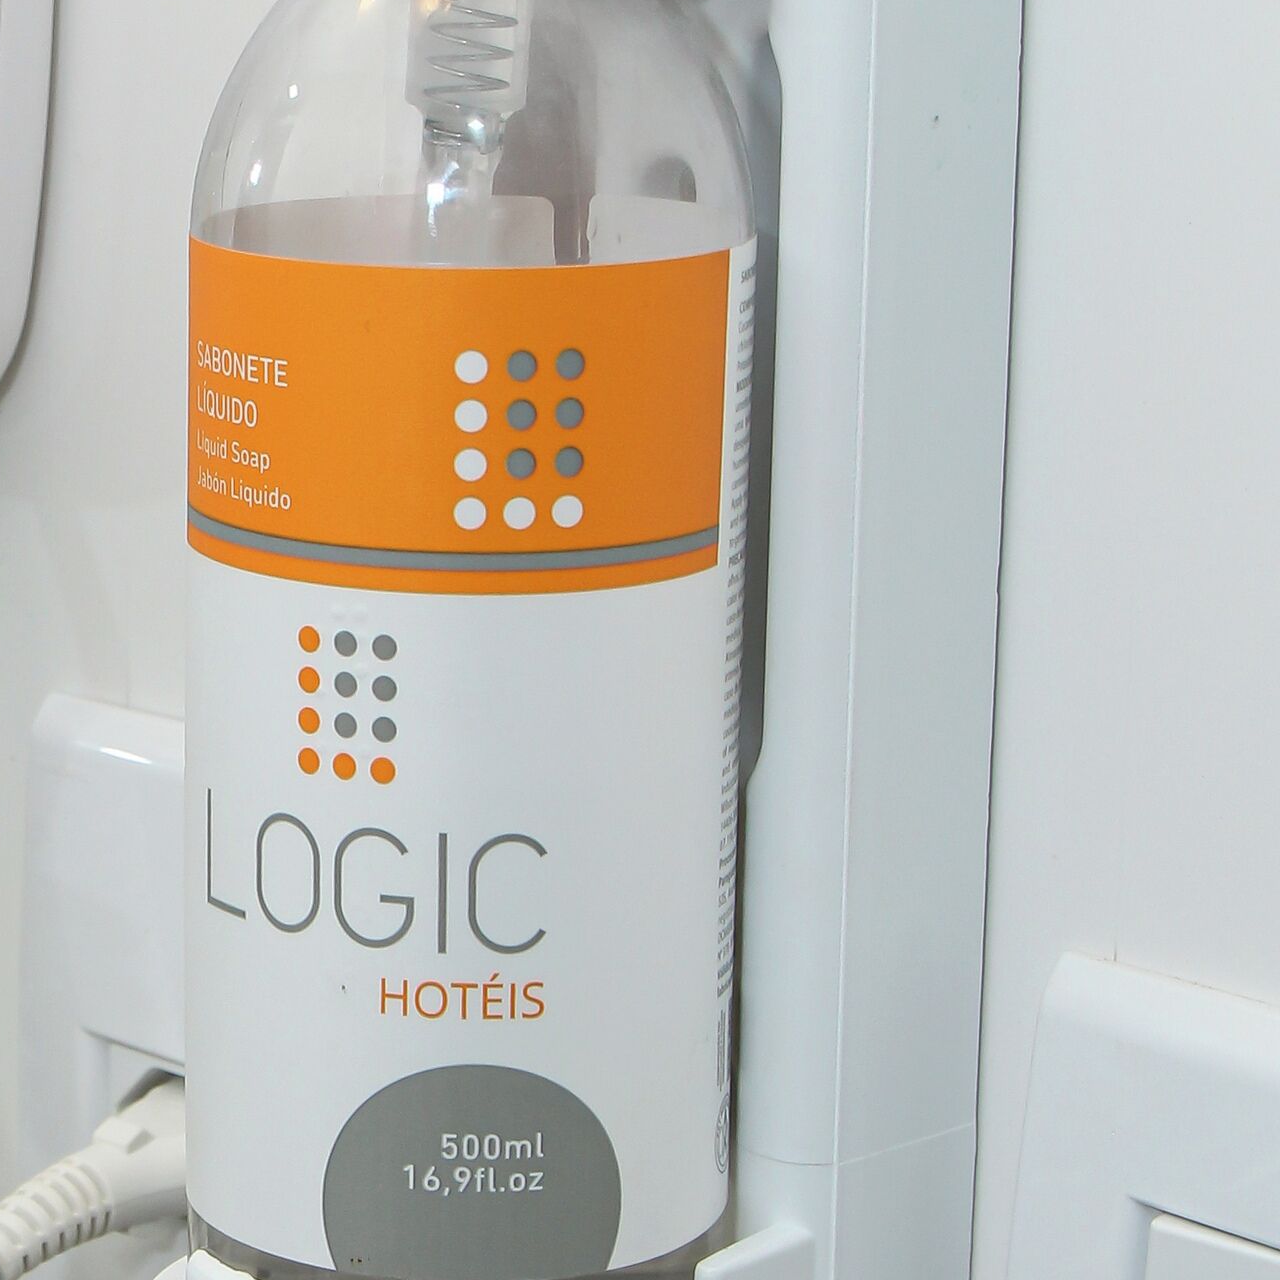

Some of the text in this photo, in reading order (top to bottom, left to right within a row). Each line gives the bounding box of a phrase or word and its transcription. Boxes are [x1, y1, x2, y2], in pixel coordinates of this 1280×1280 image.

[197, 340, 288, 387] SABONETE
[197, 381, 258, 428] LÍQUIDO
[196, 428, 271, 474] Liquid Soap
[197, 465, 291, 510] Jabón Liquido
[206, 787, 548, 955] LOGIC
[378, 972, 546, 1020] HOTÉIS
[440, 1132, 545, 1160] 500ml
[402, 1164, 545, 1197] 16,9fl.oz
